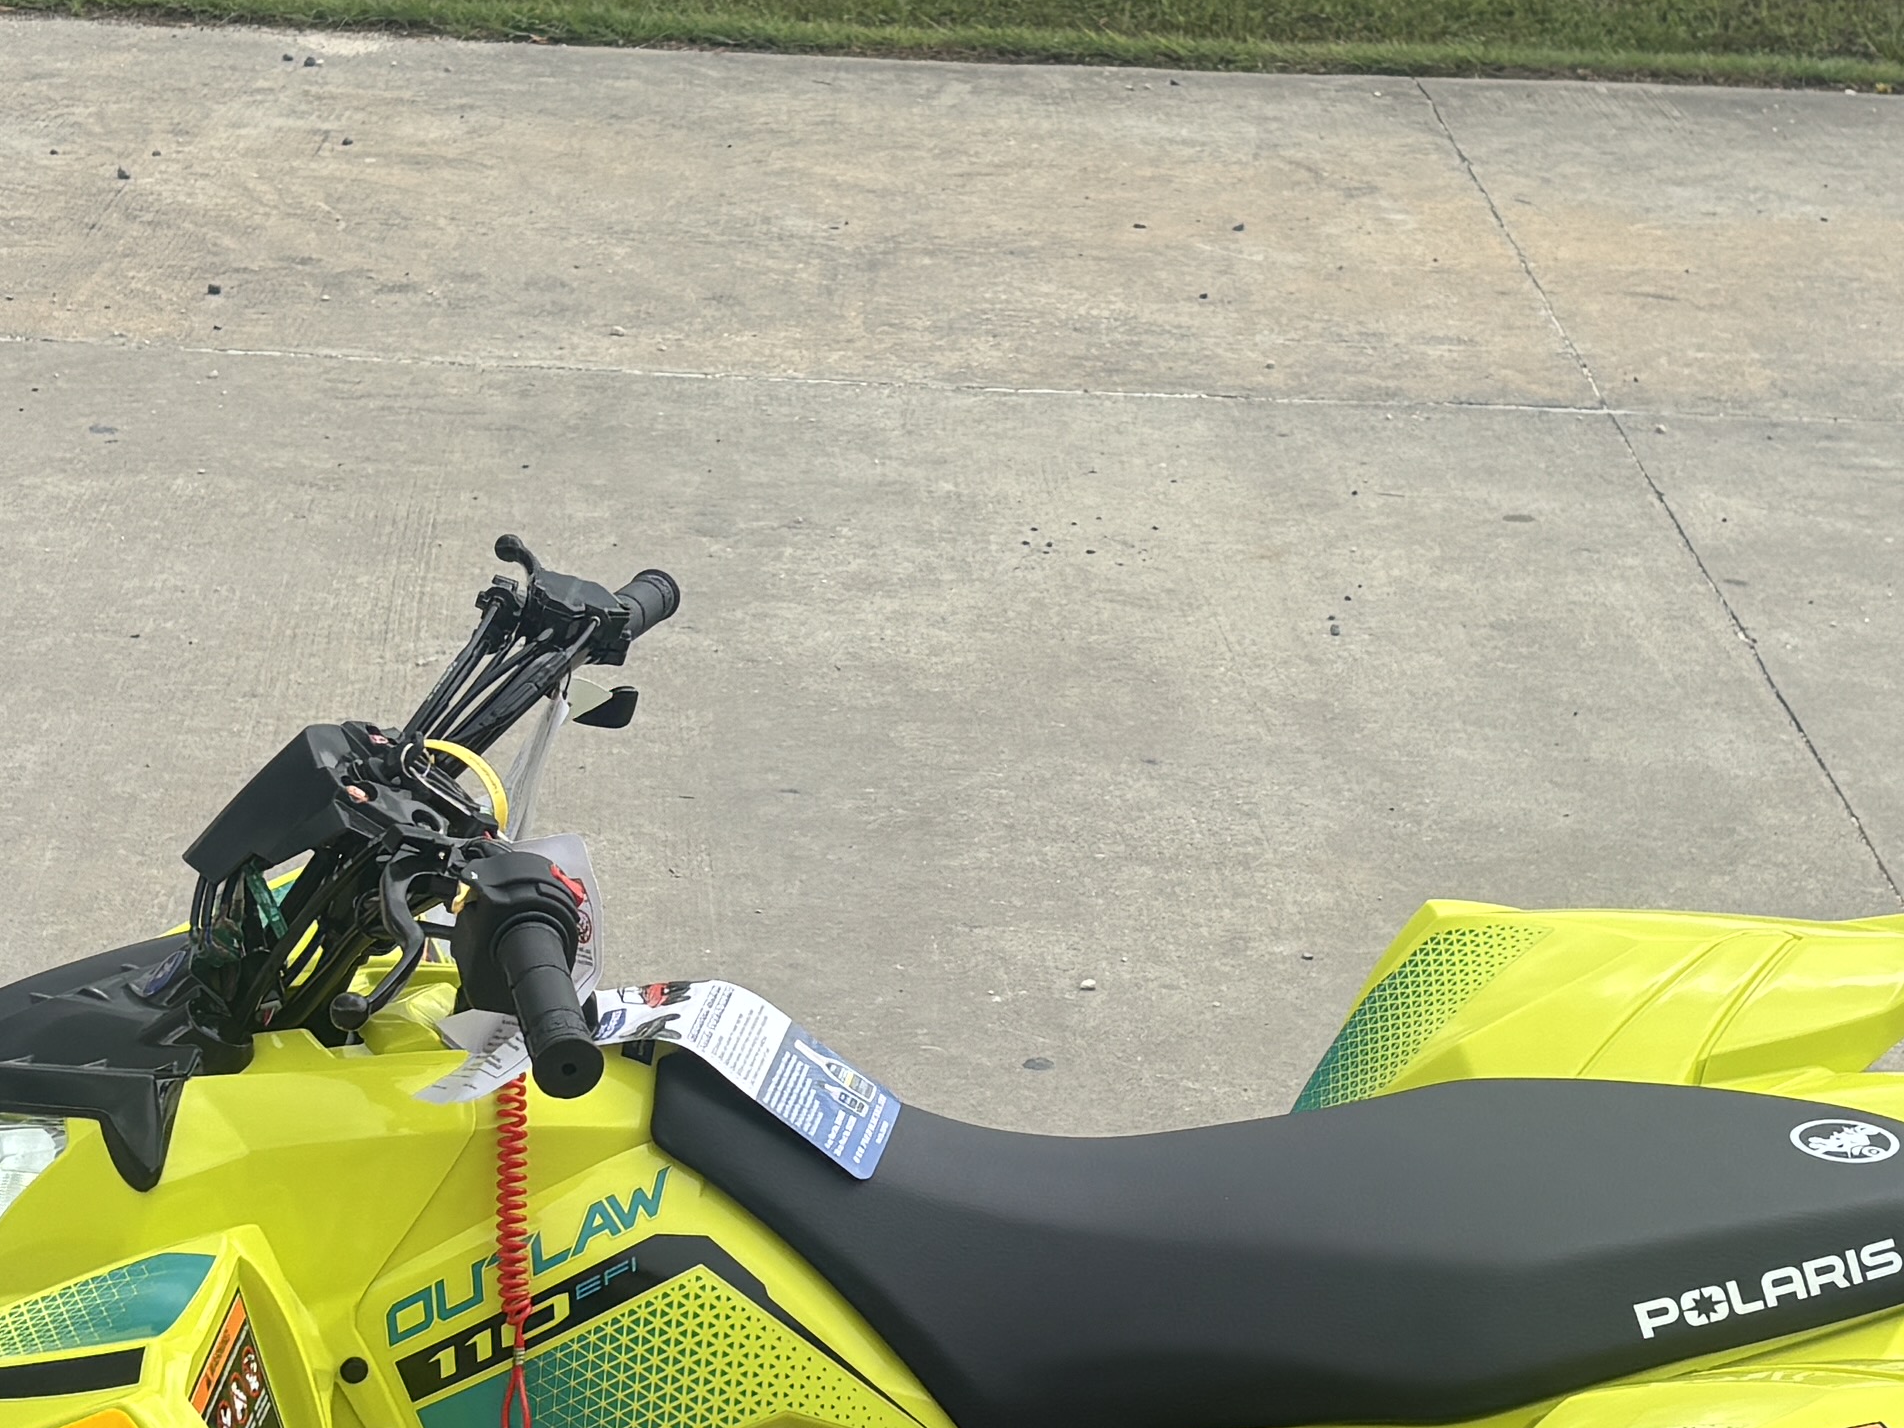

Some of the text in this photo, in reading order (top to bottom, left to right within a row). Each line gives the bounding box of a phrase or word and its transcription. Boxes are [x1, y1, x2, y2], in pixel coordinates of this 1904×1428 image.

[428, 1256, 638, 1379] 110 EFI
[1632, 1237, 1904, 1340] POLARIS
